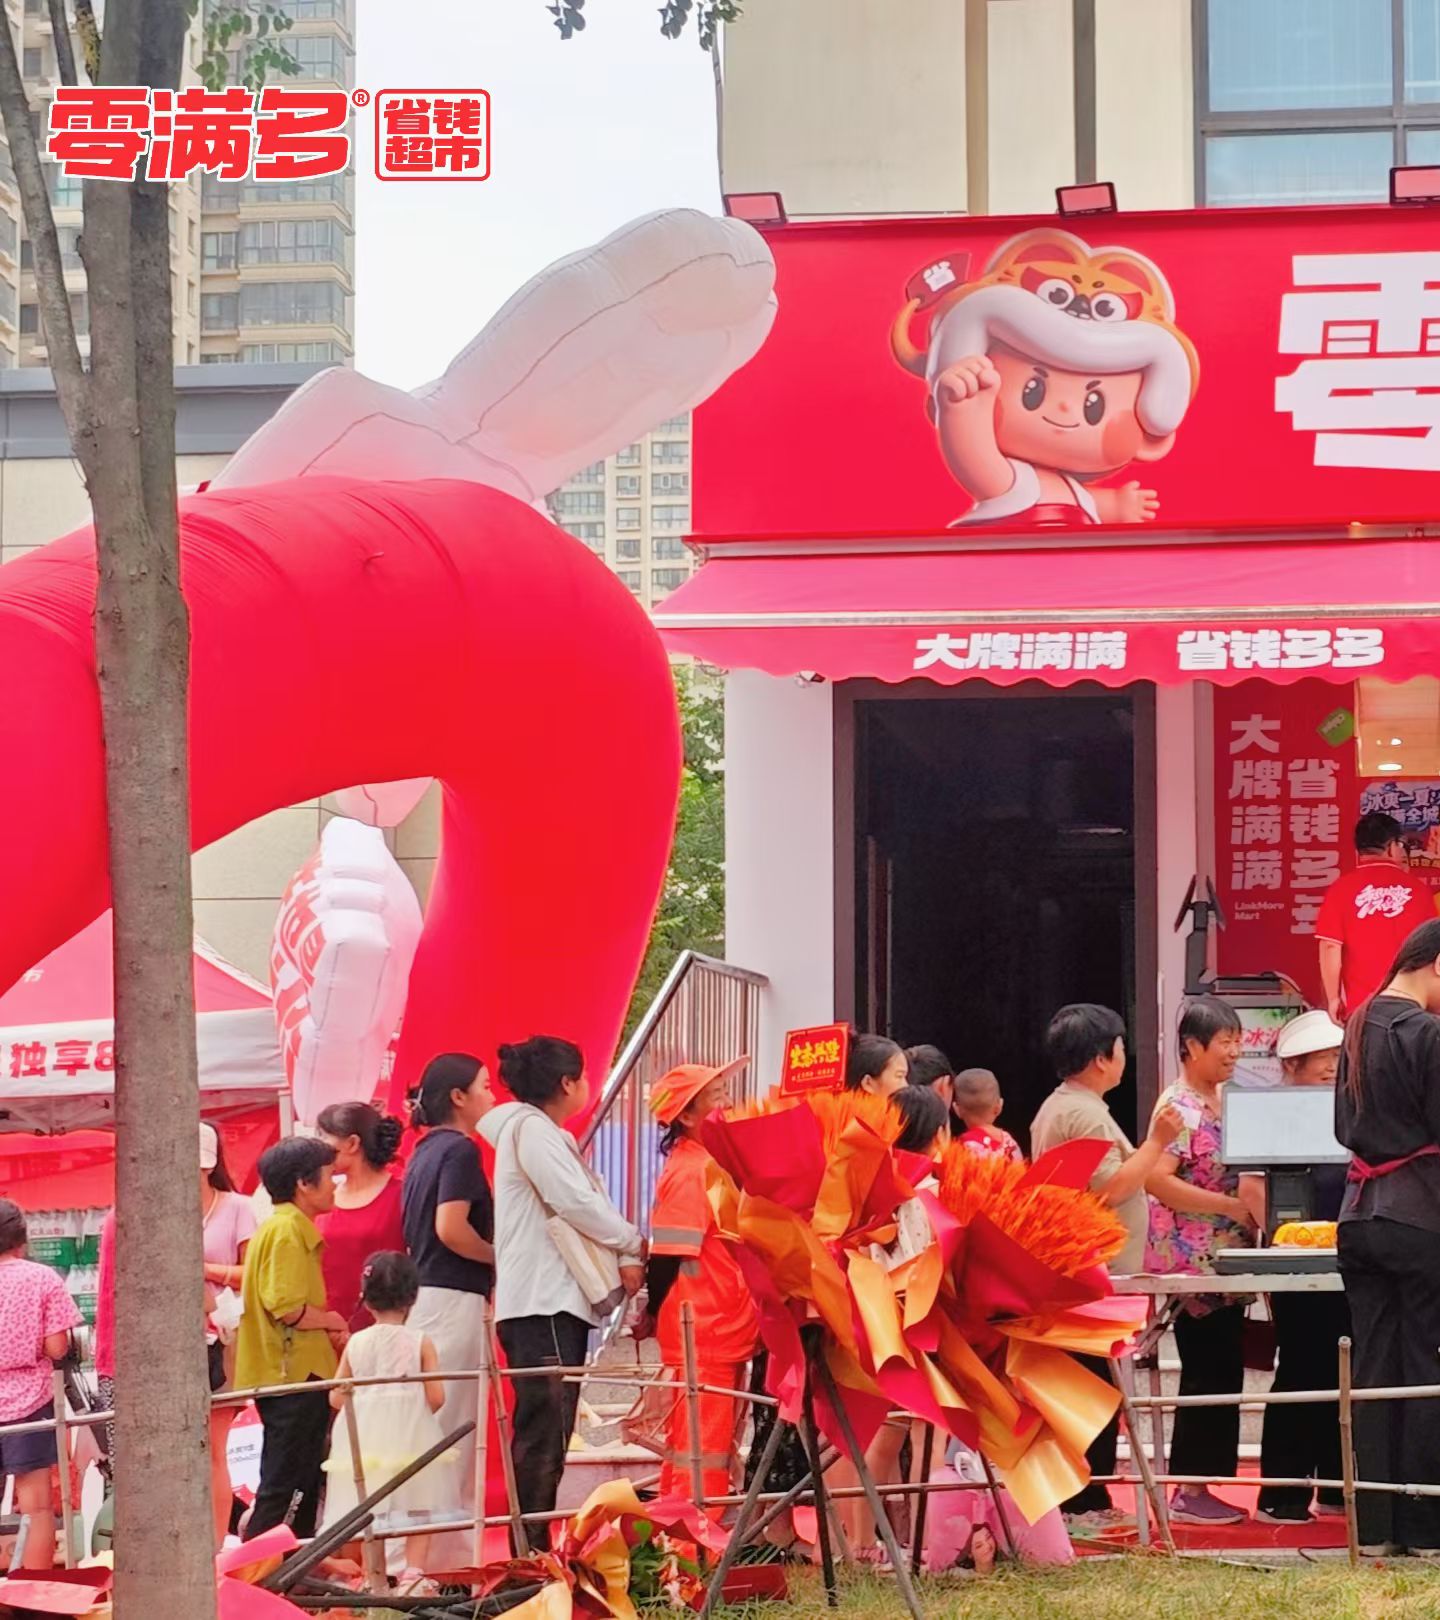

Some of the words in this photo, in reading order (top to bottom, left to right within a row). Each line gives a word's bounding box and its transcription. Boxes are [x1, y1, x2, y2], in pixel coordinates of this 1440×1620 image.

[913, 631, 1128, 670] 大牌满满
[1177, 628, 1385, 671] 省钱多多
[1228, 713, 1284, 891] 大牌满满
[1234, 900, 1285, 911] LinkMore
[1234, 911, 1261, 921] Mart
[0, 1040, 114, 1079] 独享8
